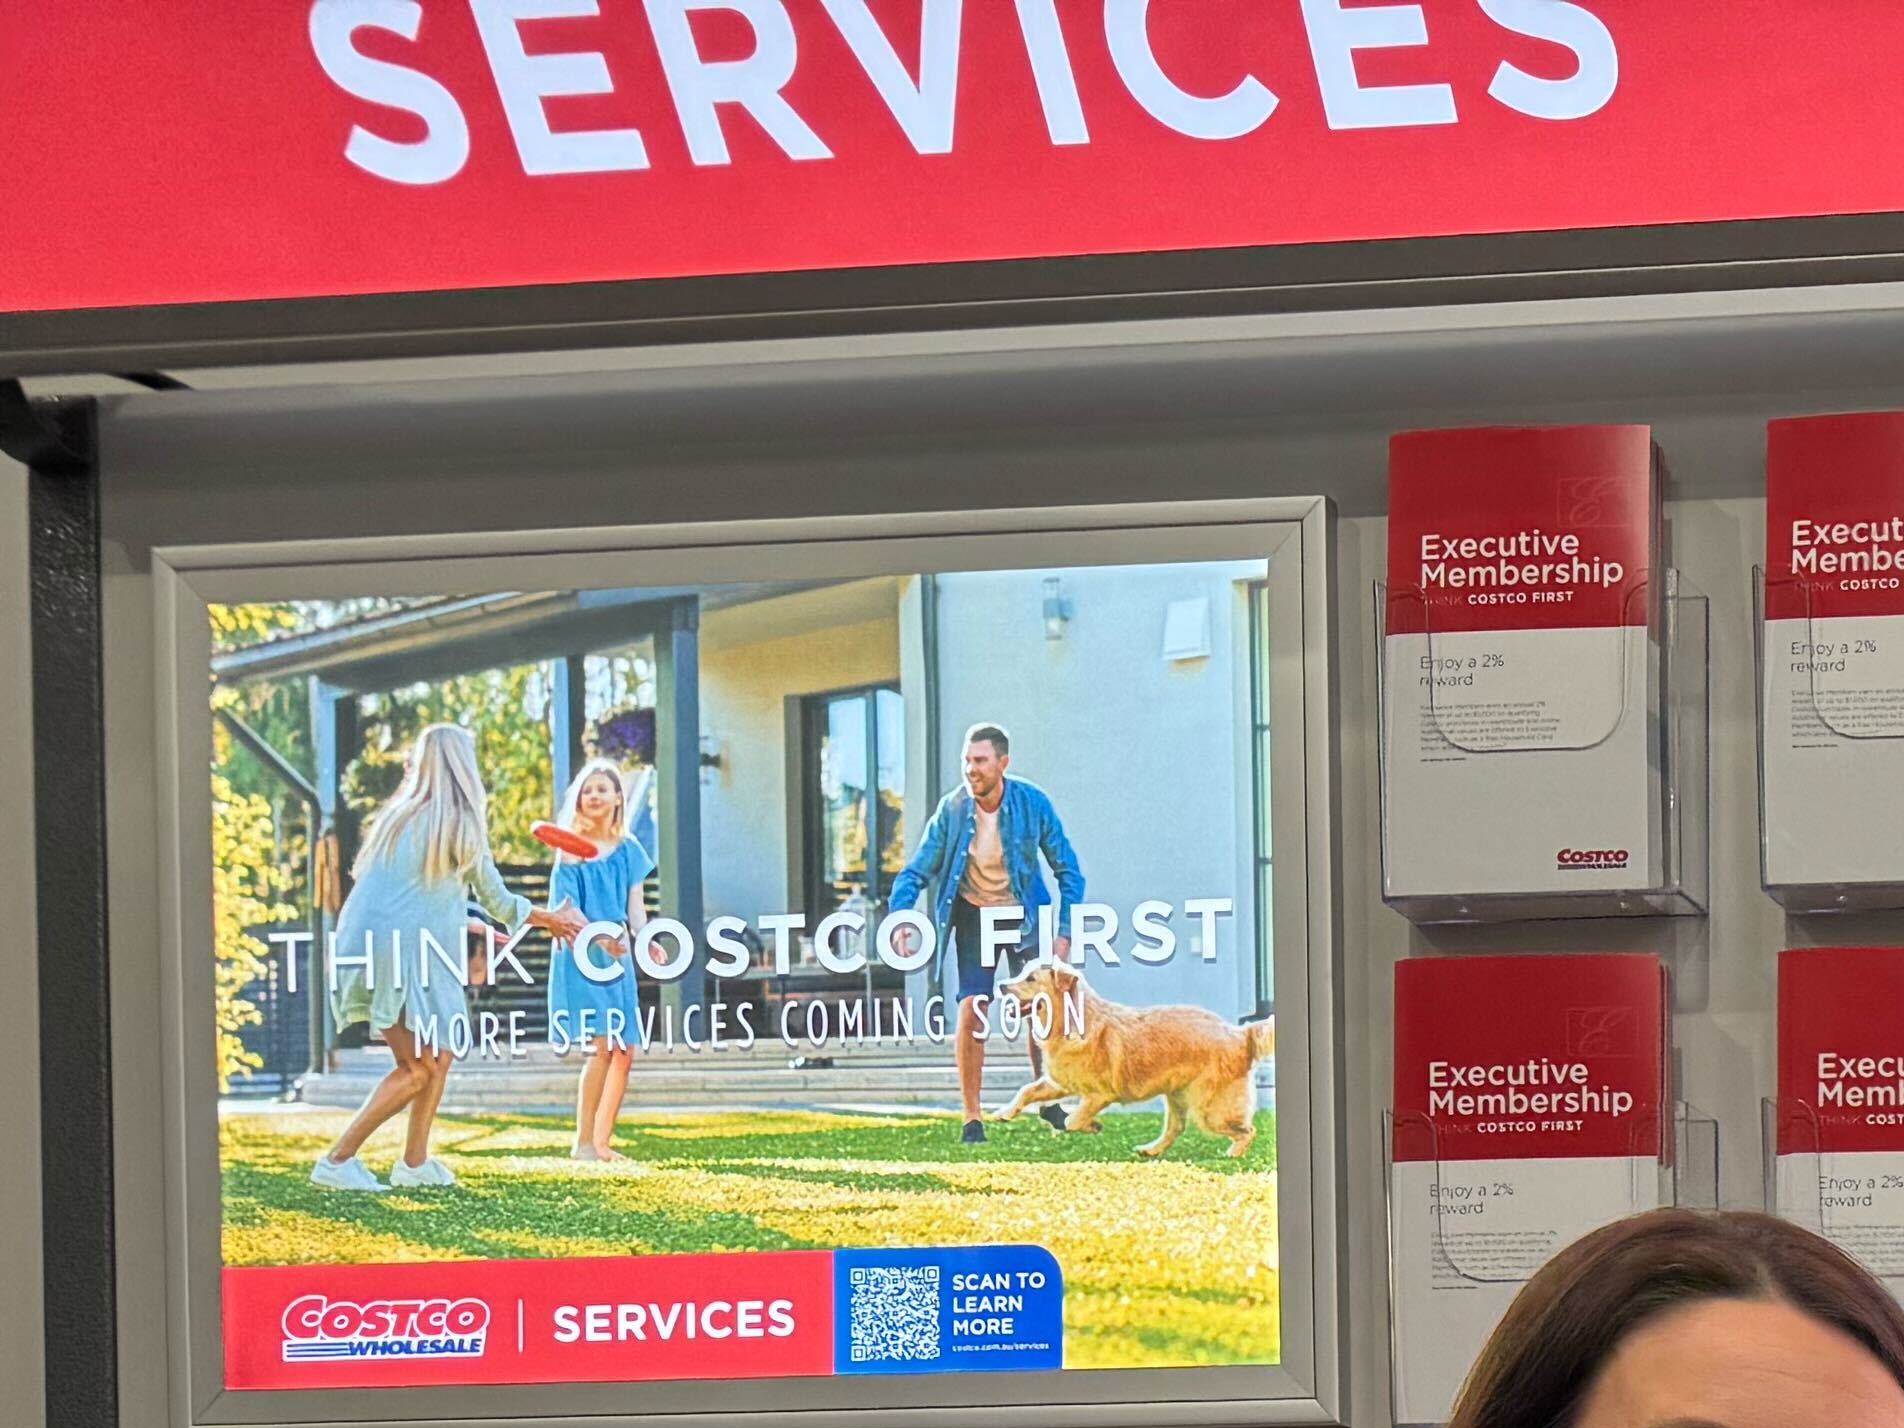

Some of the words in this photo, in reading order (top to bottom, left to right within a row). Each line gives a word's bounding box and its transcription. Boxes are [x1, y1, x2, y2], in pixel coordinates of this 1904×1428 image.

[1421, 529, 1580, 560] Executive
[1421, 557, 1624, 589] Membership
[1468, 592, 1526, 605] COSTCO
[1532, 591, 1574, 603] FIRST
[270, 921, 536, 994] THINK
[574, 912, 936, 984] COSTCO
[981, 898, 1232, 969] FIRST
[414, 1008, 527, 1059] MORE
[550, 1001, 756, 1053] SERVICES
[780, 995, 946, 1044] COMING
[972, 989, 1088, 1039] SOON
[952, 1273, 1010, 1291] SCAN
[1015, 1272, 1046, 1289] TO
[282, 1295, 490, 1339] COSTCO
[953, 1296, 1023, 1313] LEARN
[553, 1300, 795, 1343] SERVICES
[953, 1318, 1013, 1337] MORE
[348, 1336, 483, 1357] WHOLESALE
